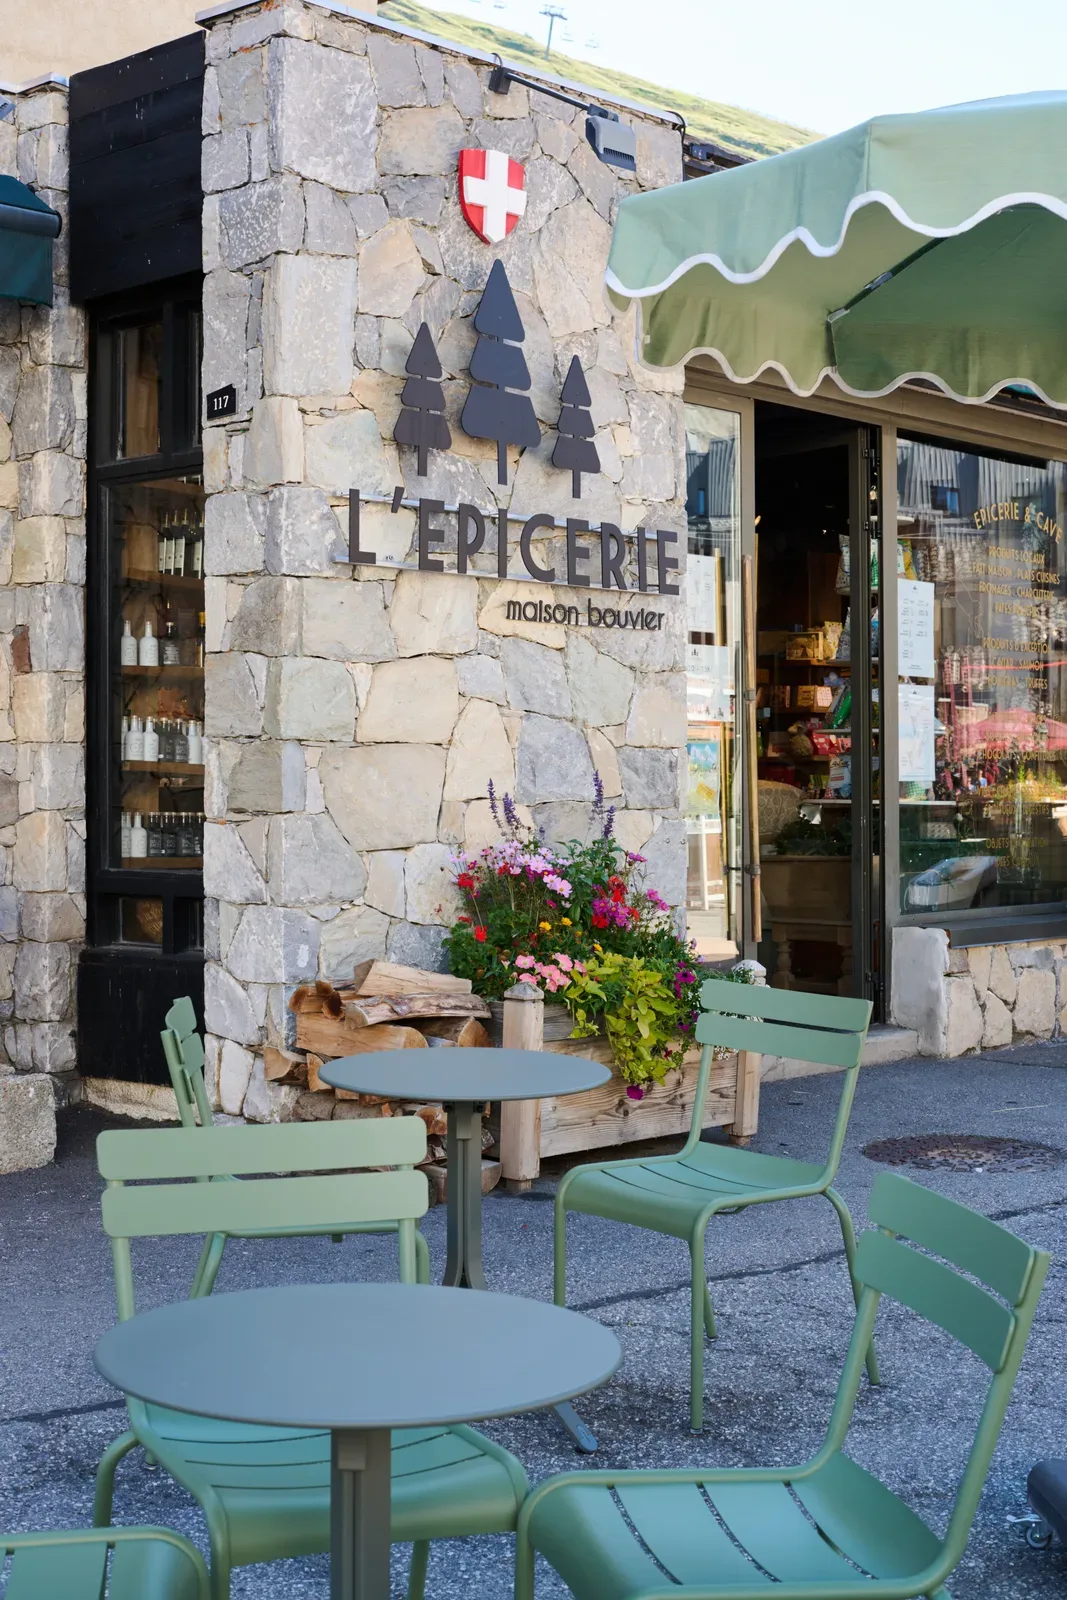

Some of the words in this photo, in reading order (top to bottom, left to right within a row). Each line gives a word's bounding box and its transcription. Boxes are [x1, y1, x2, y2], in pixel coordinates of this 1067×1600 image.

[214, 395, 229, 411] 117
[974, 502, 1020, 530] EPICERIE
[1025, 506, 1031, 524] &
[1037, 511, 1063, 545] CAVE
[348, 486, 680, 595] L'EPICERIE
[989, 545, 1019, 561] PRODUITS
[1021, 550, 1046, 565] LOCAUX
[973, 562, 986, 575] FAIT
[988, 563, 1013, 577] MAISON
[1018, 567, 1035, 581] PLATS
[979, 581, 1012, 597] FROMAGES
[1017, 587, 1056, 601] CHARCUTERIE
[506, 599, 580, 626] maison
[588, 598, 665, 631] bouvier
[983, 637, 1013, 651] PRODUITS
